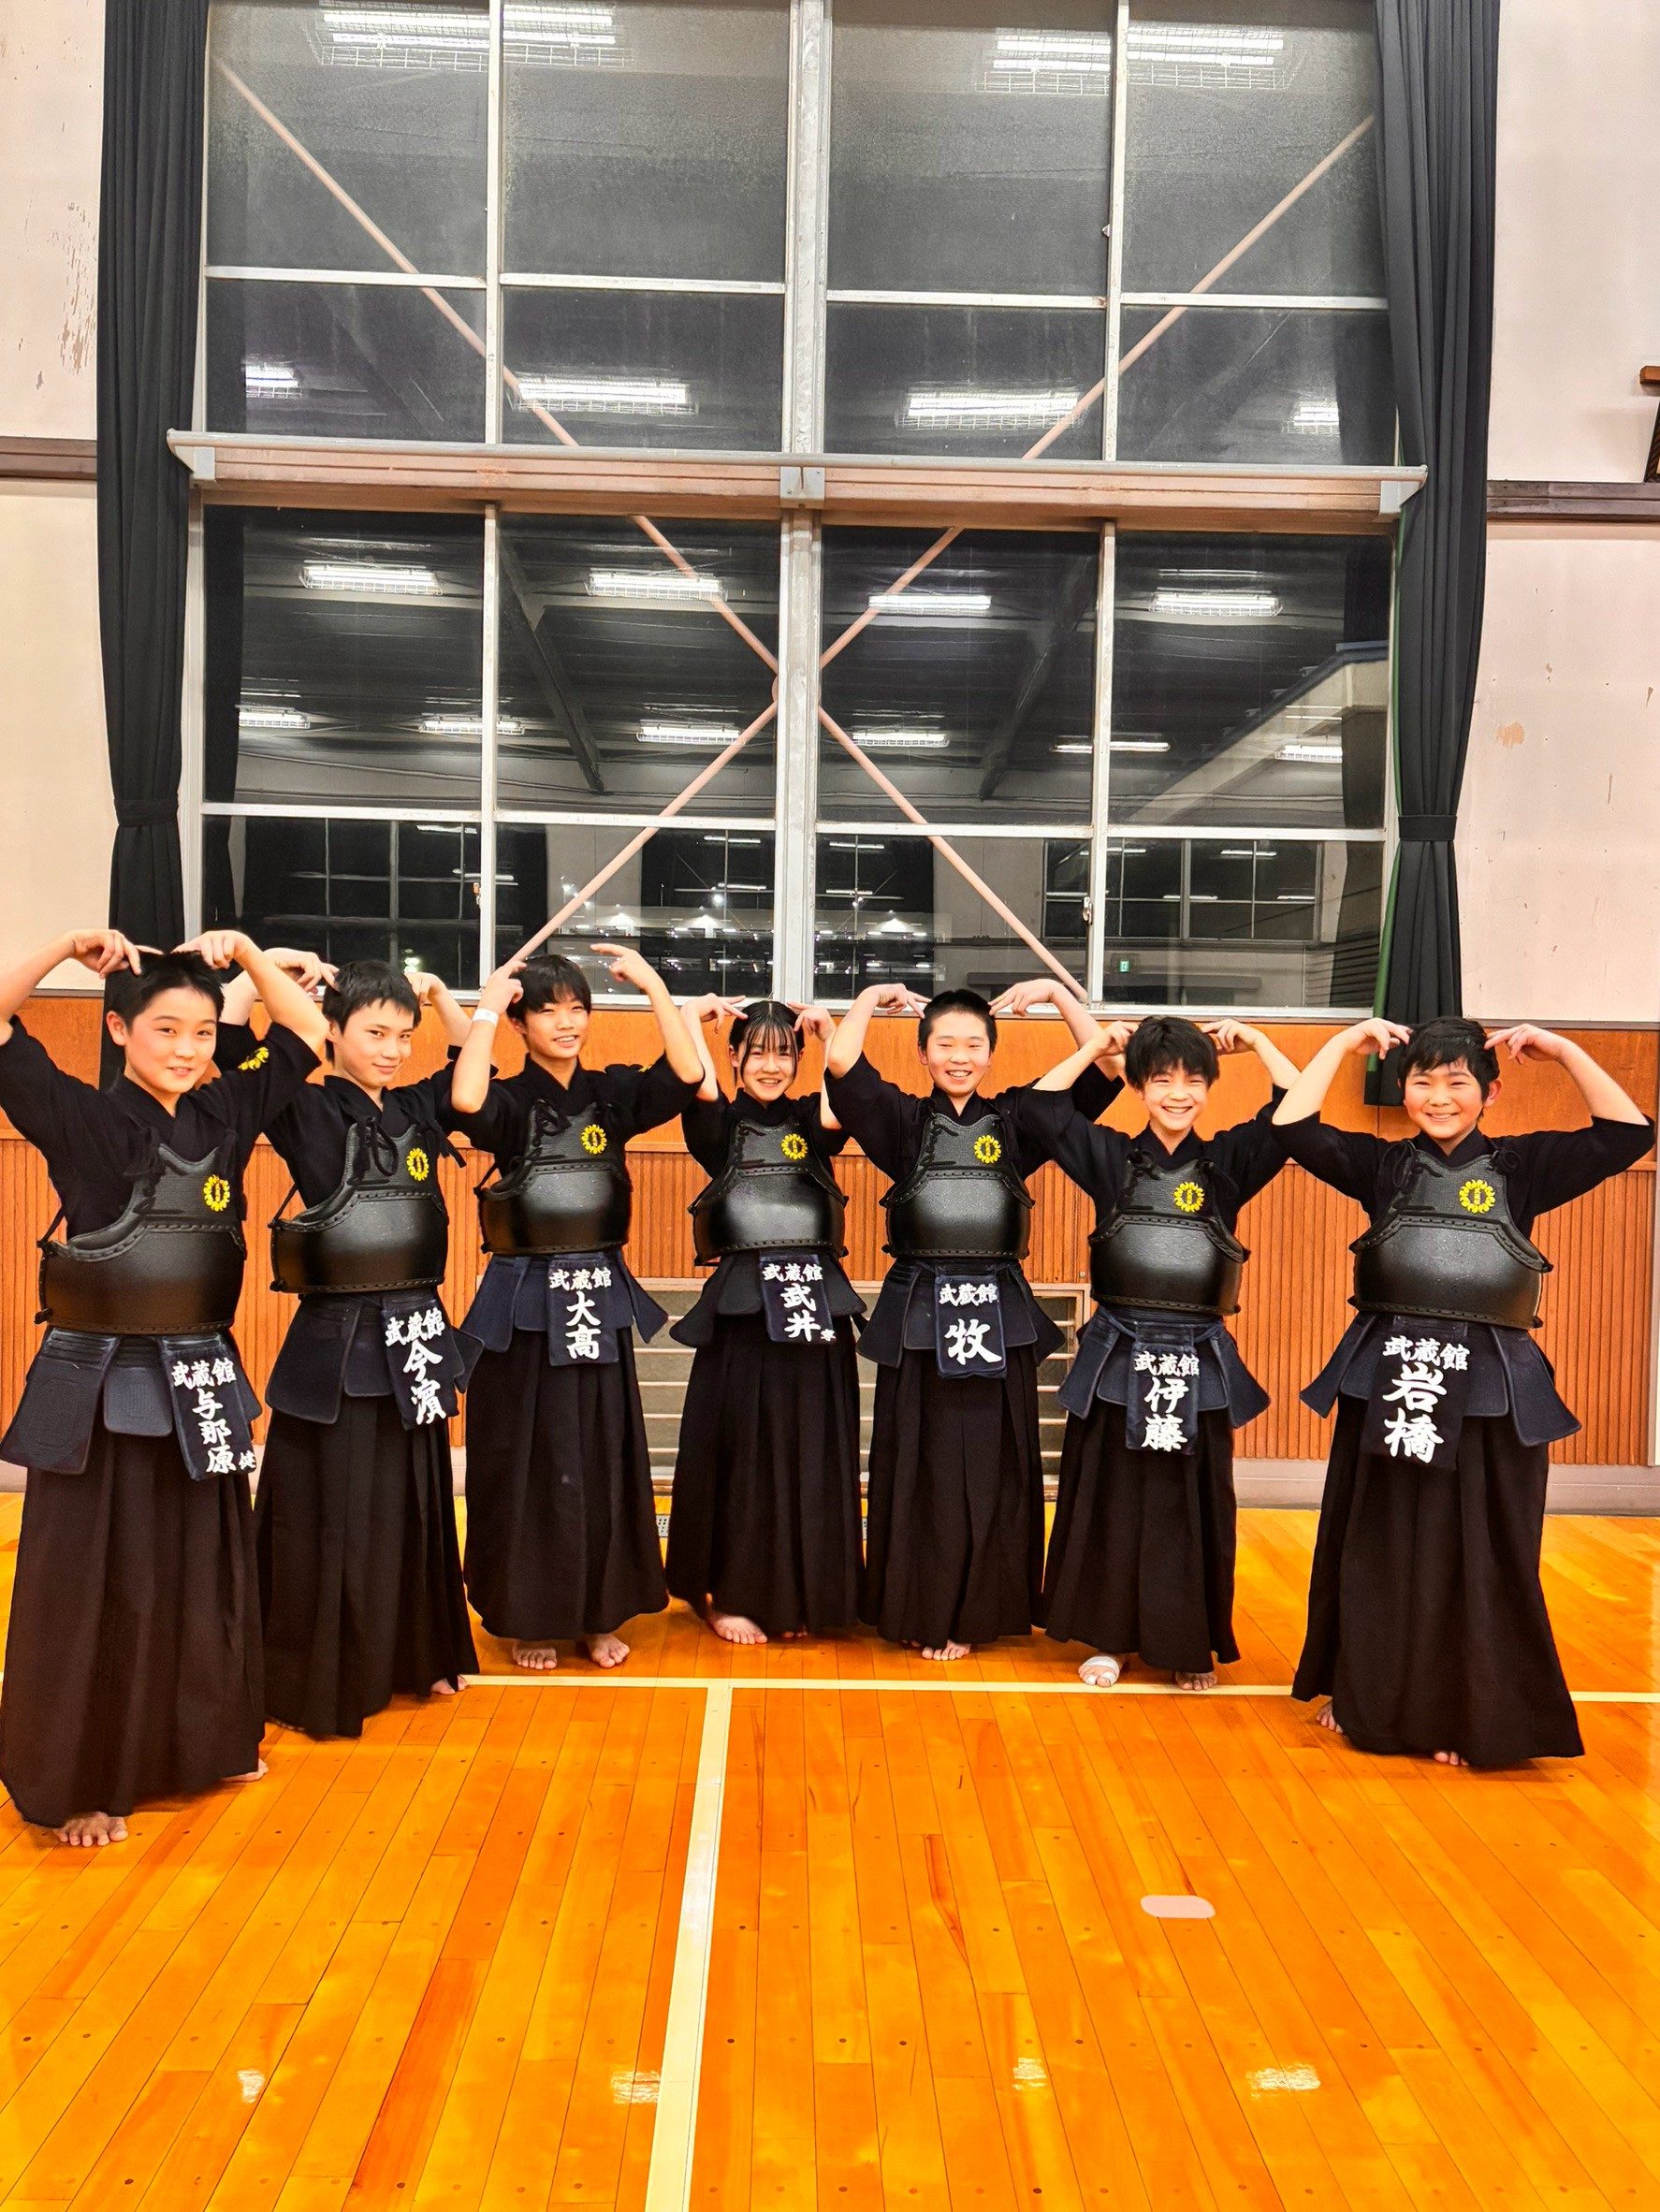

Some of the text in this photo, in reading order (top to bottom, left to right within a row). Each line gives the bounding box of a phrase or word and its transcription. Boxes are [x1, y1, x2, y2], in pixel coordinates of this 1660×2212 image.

[548, 1266, 612, 1290] 武蔵館
[762, 1263, 823, 1283] 武蔵館
[779, 1282, 822, 1342] 武井
[939, 1283, 998, 1306] 武蔵館
[386, 1307, 445, 1346] 武蔵館
[944, 1318, 1003, 1365] 牧
[1133, 1350, 1200, 1376] 武蔵館
[1382, 1334, 1470, 1371] 武蔵館
[171, 1357, 237, 1390] 武蔵館
[192, 1388, 236, 1474] 与那原
[1142, 1376, 1189, 1452] 伊藤
[1382, 1361, 1448, 1463] 岩橋
